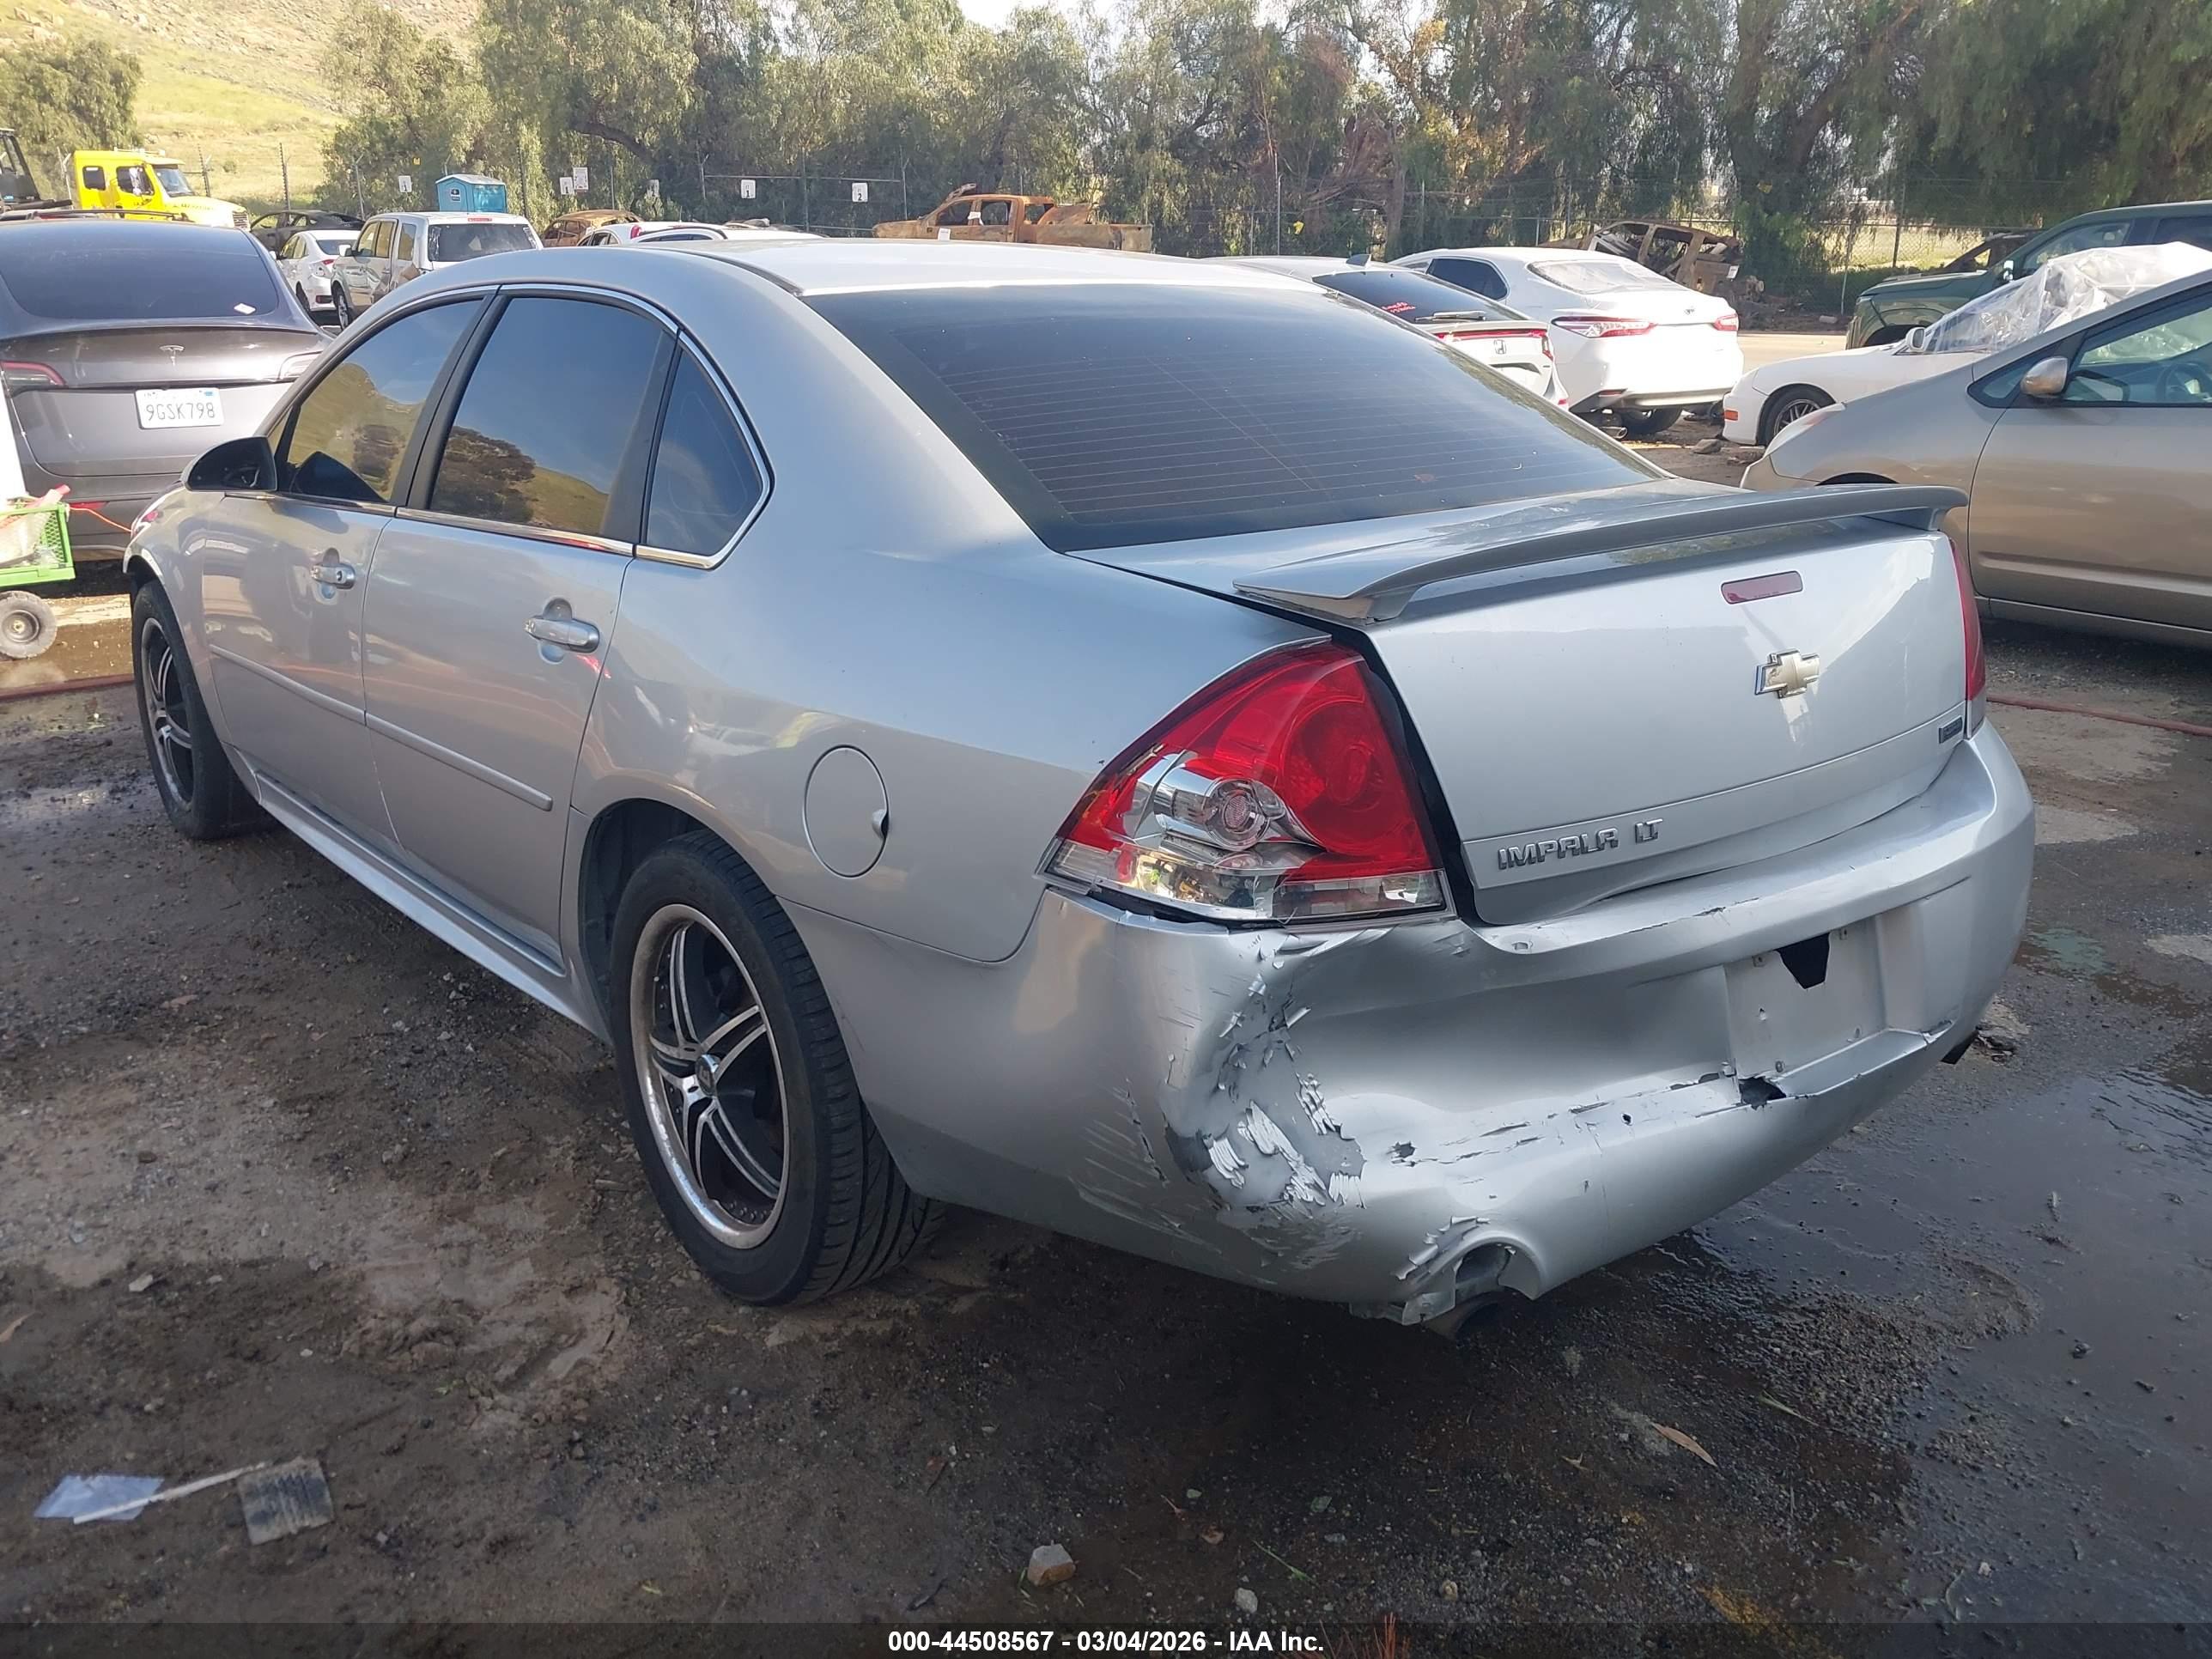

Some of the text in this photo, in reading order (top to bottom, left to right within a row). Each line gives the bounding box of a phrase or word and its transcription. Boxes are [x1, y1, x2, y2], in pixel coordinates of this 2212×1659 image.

[146, 402, 215, 421] 9GSK798
[1498, 818, 1663, 871] IMPALA LT
